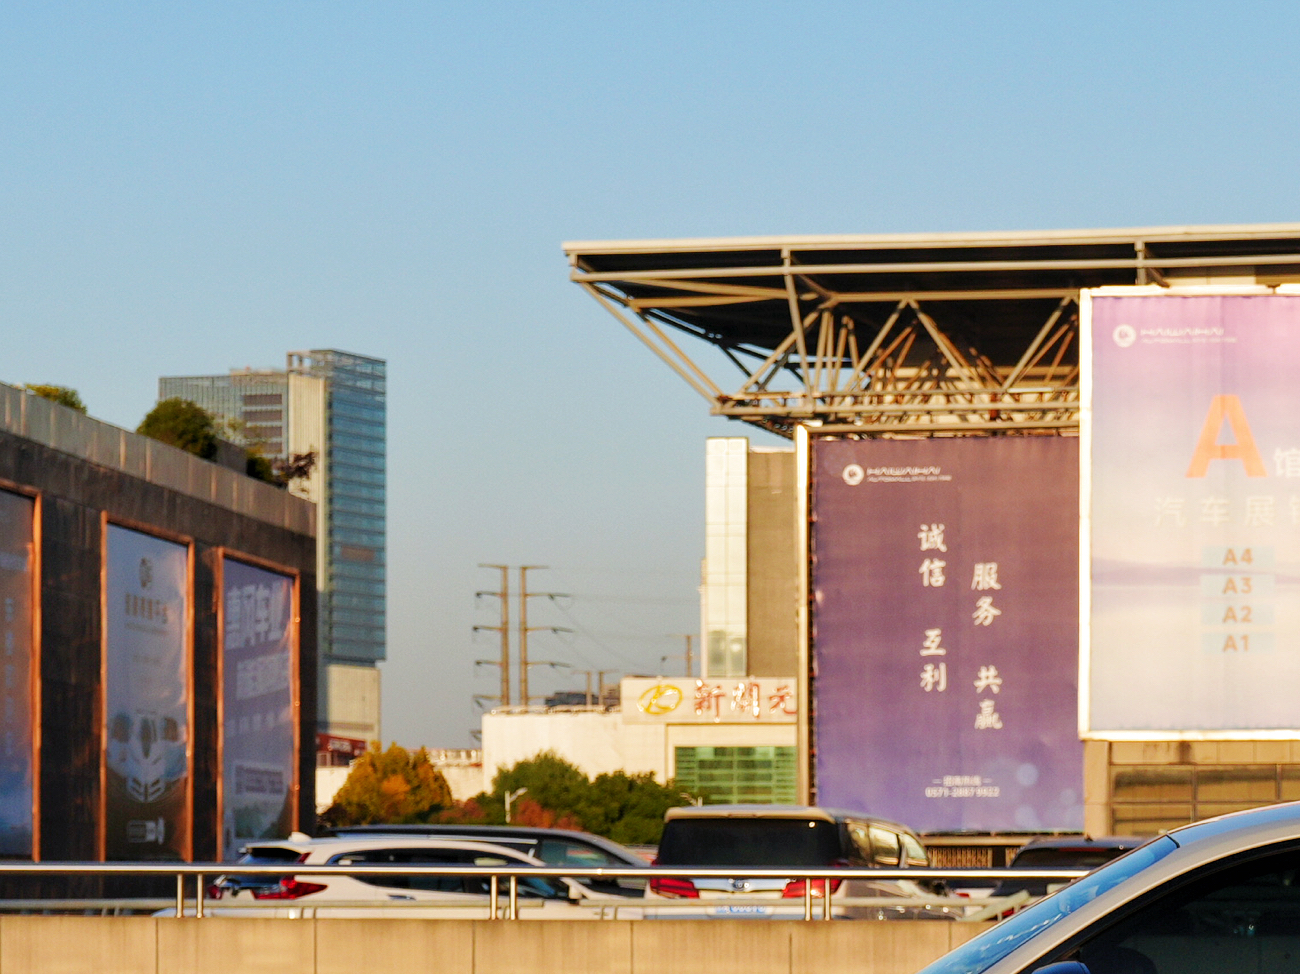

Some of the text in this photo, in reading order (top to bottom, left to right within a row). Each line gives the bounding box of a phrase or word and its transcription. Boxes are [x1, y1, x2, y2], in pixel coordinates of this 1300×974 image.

[1222, 547, 1254, 566] A4
[1222, 576, 1253, 595] A3
[917, 523, 948, 693] 诚信 互利
[1222, 605, 1253, 624] A2
[970, 561, 1004, 730] 服务 共赢
[1222, 634, 1250, 653] A1
